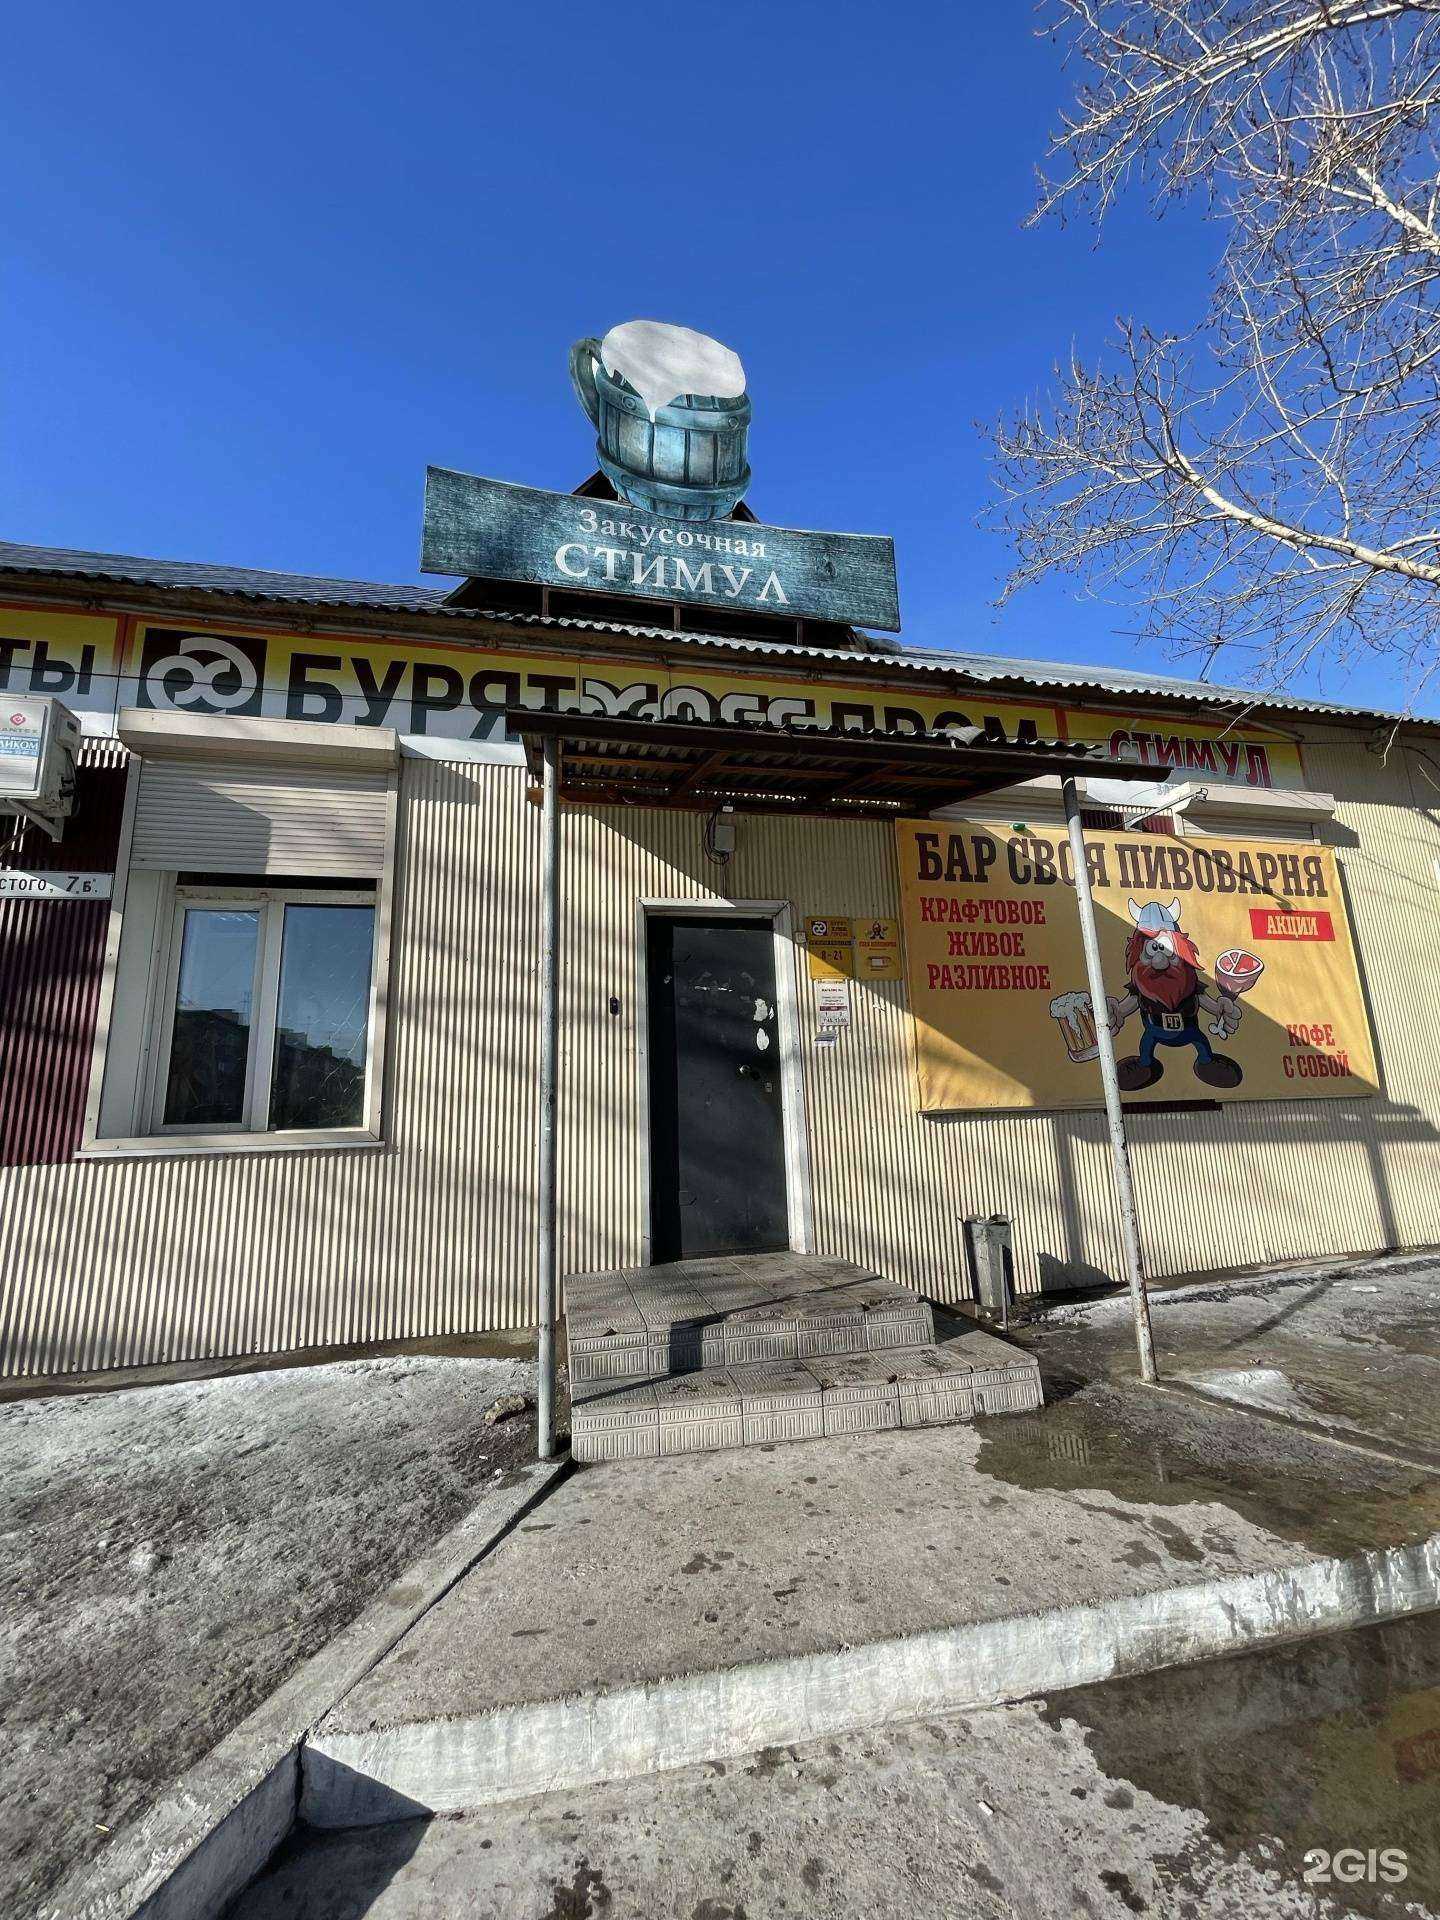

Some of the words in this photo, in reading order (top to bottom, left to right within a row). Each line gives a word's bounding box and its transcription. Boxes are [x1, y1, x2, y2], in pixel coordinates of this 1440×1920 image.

[578, 509, 767, 558] Закусочная
[554, 543, 790, 605] СТИМУЛ
[1110, 731, 1271, 788] СТИМУЛ
[915, 832, 997, 883] БАР
[1007, 837, 1111, 888] СВОЯ
[1114, 843, 1329, 898] ПИВОВАРНЯ
[920, 896, 1046, 925] КРАФТОВОЕ
[1266, 914, 1319, 938] АКЦИИ
[947, 931, 1026, 957] ЖИВОЕ
[927, 963, 1051, 990] РАЗЛИВНОЕ
[1286, 1024, 1336, 1046] КОФЕ
[1283, 1055, 1294, 1078] С
[1296, 1050, 1353, 1078] СОБОЙ
